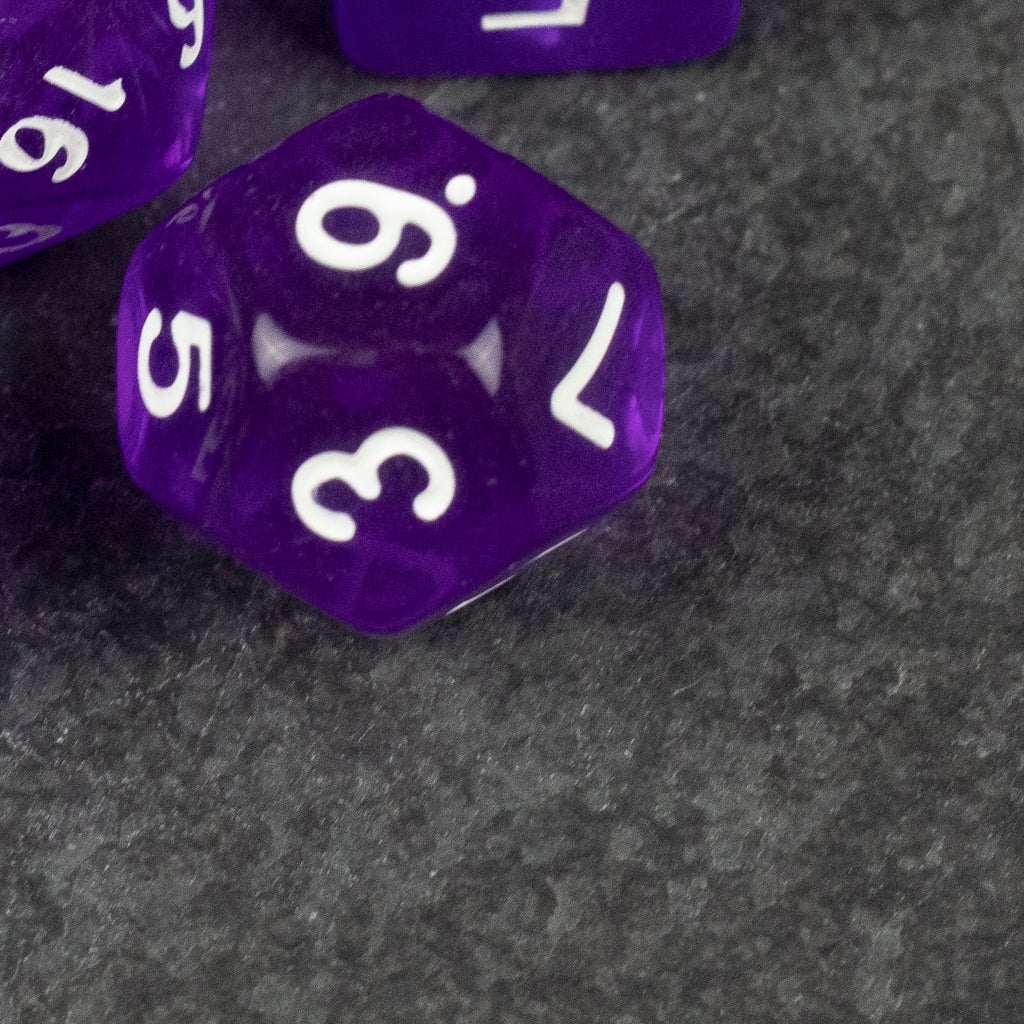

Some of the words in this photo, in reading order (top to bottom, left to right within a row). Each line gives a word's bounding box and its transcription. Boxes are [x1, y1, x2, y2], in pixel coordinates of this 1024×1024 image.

[138, 308, 212, 418] 5
[551, 282, 625, 449] 7
[291, 427, 456, 541] 3
